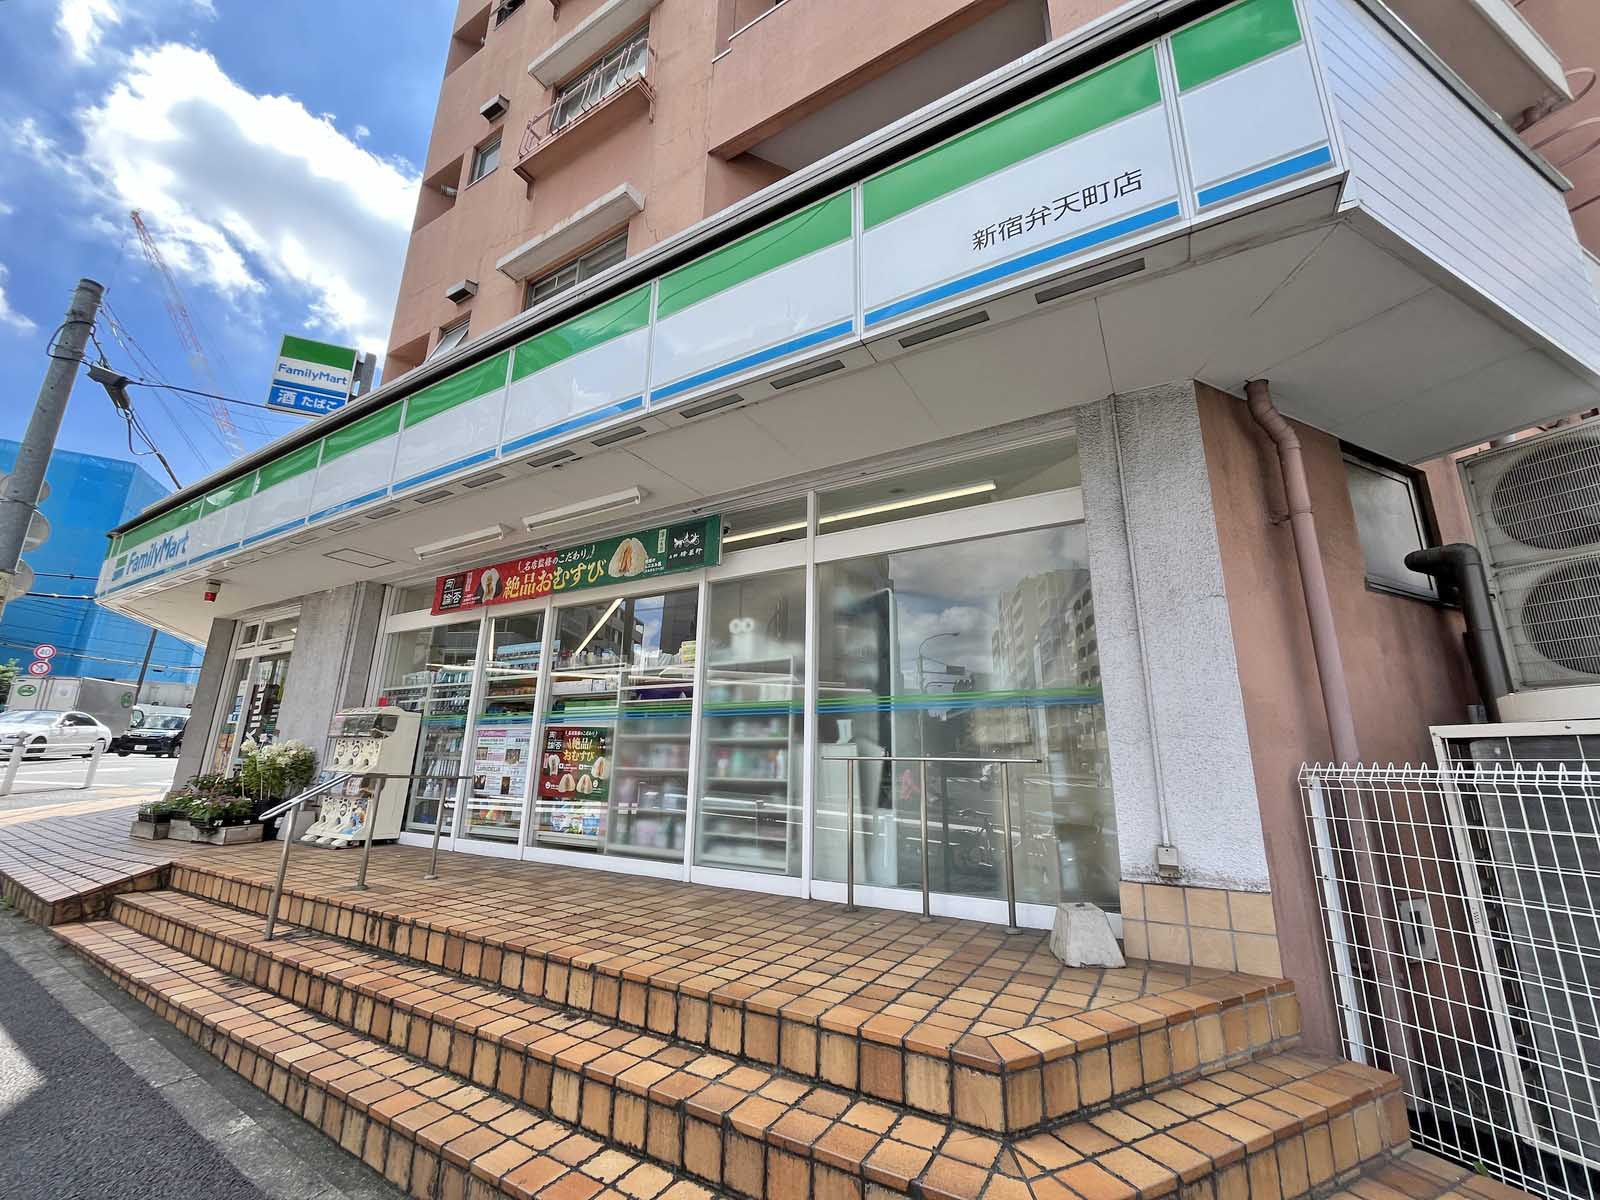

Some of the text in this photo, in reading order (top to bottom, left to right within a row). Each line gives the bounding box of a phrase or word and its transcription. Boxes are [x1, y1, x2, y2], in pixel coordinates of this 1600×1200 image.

[972, 169, 1142, 250] 新宿弁天町店
[278, 363, 348, 385] FamilyMart
[277, 389, 338, 411] 酒 たばこ
[126, 529, 189, 575] FamilyMart
[503, 559, 607, 599] 絶品おむすび
[563, 749, 595, 762] おむすび
